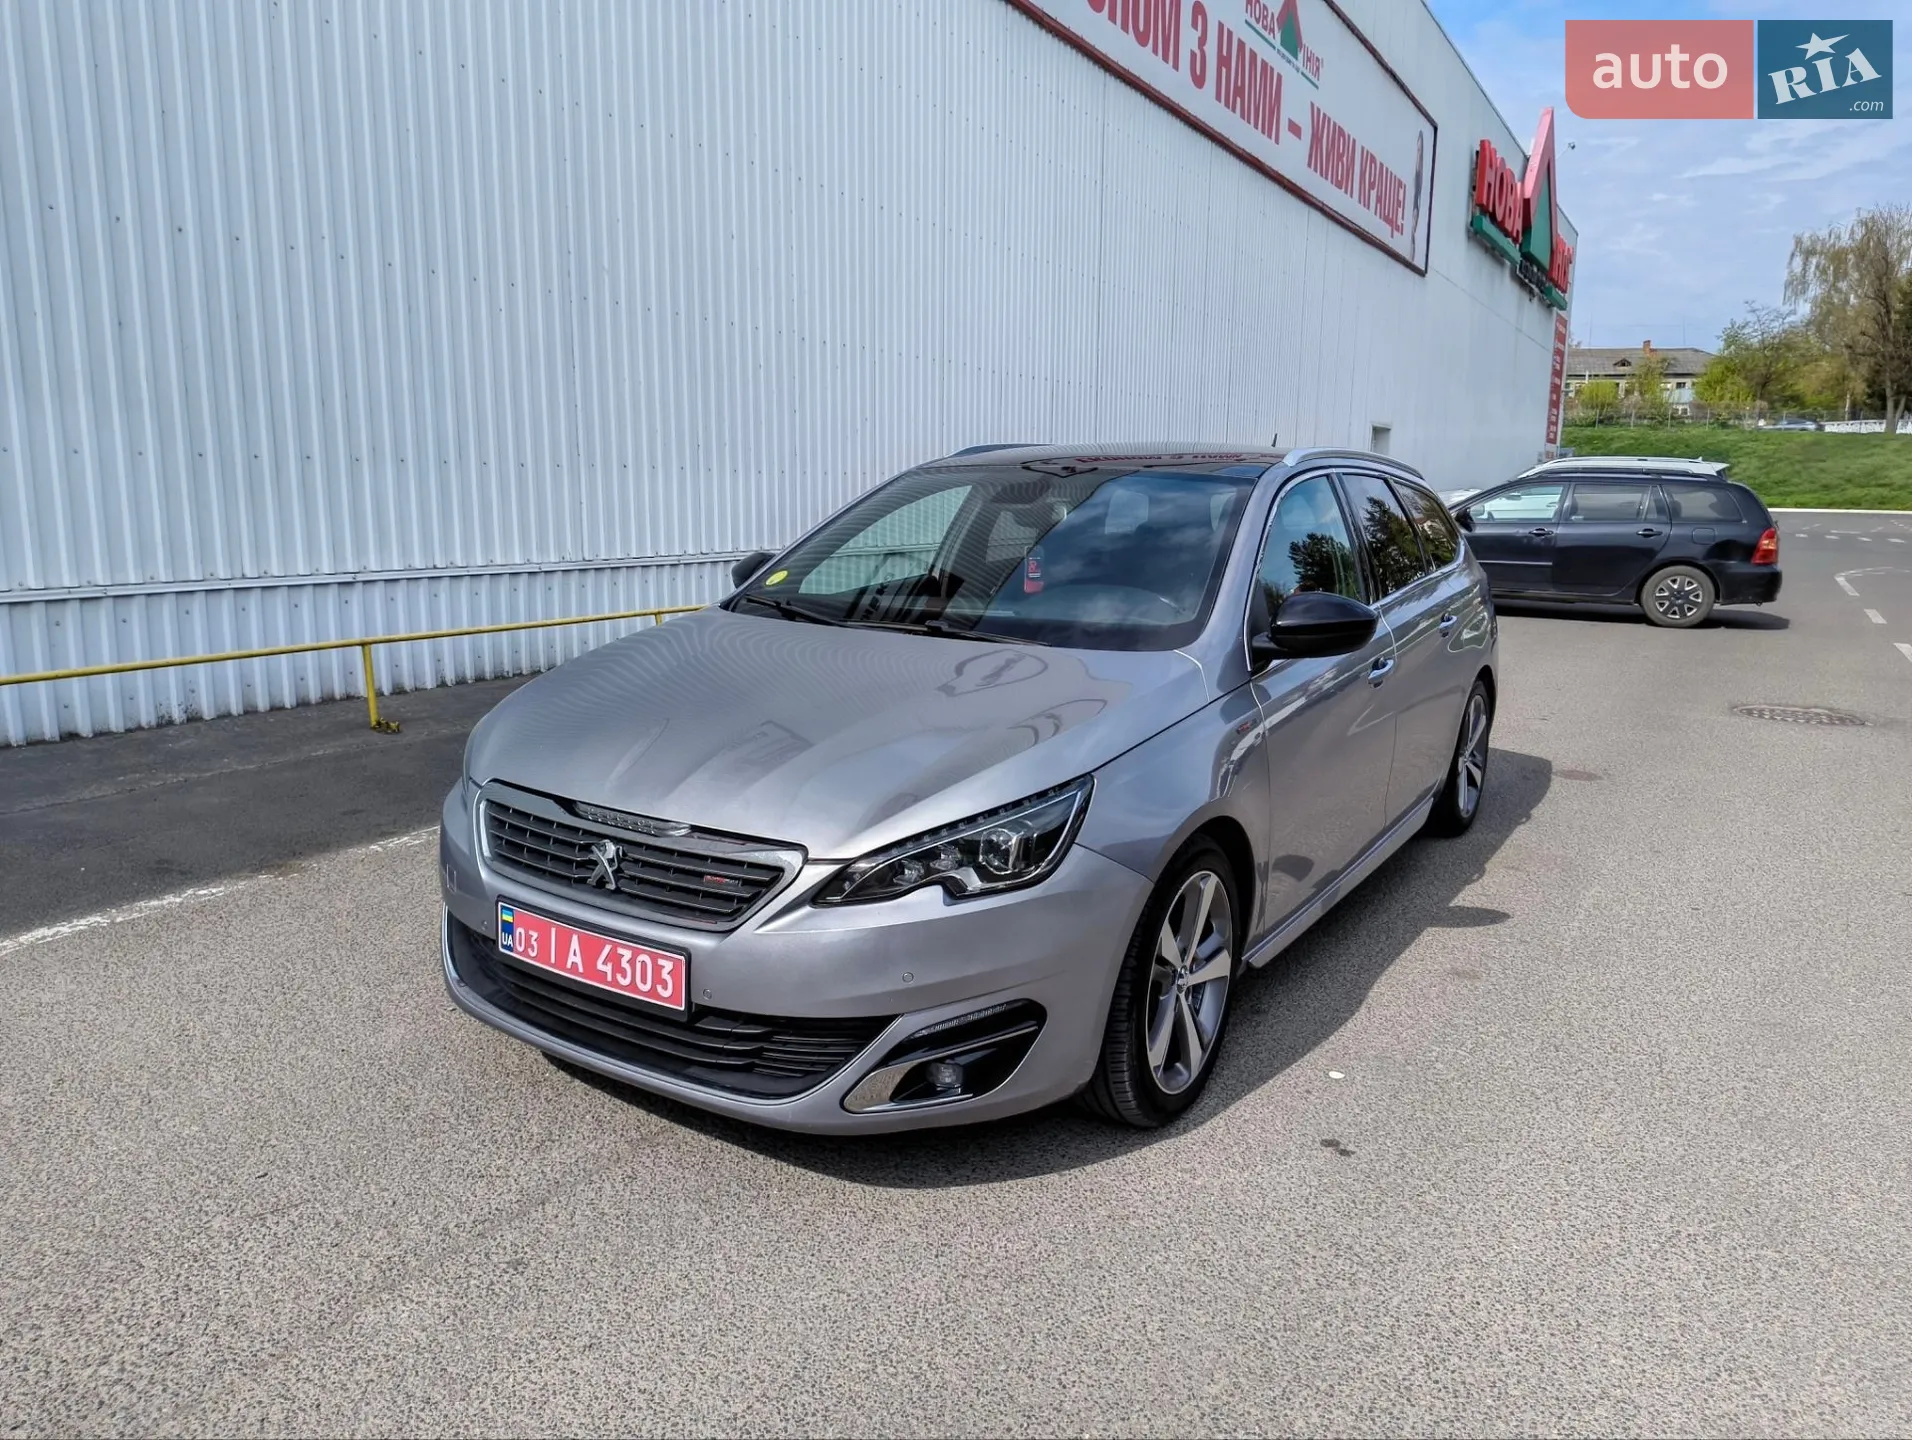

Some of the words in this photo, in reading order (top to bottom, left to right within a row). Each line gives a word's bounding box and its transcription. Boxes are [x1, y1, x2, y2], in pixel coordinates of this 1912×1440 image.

[1215, 20, 1283, 146] НАМИ
[1307, 100, 1357, 199] ЖИВИ
[1358, 144, 1407, 239] КРАЩЕ!
[1476, 139, 1523, 244] НОВА
[502, 931, 514, 948] UA
[515, 927, 540, 958] 03
[596, 944, 674, 998] 4303
